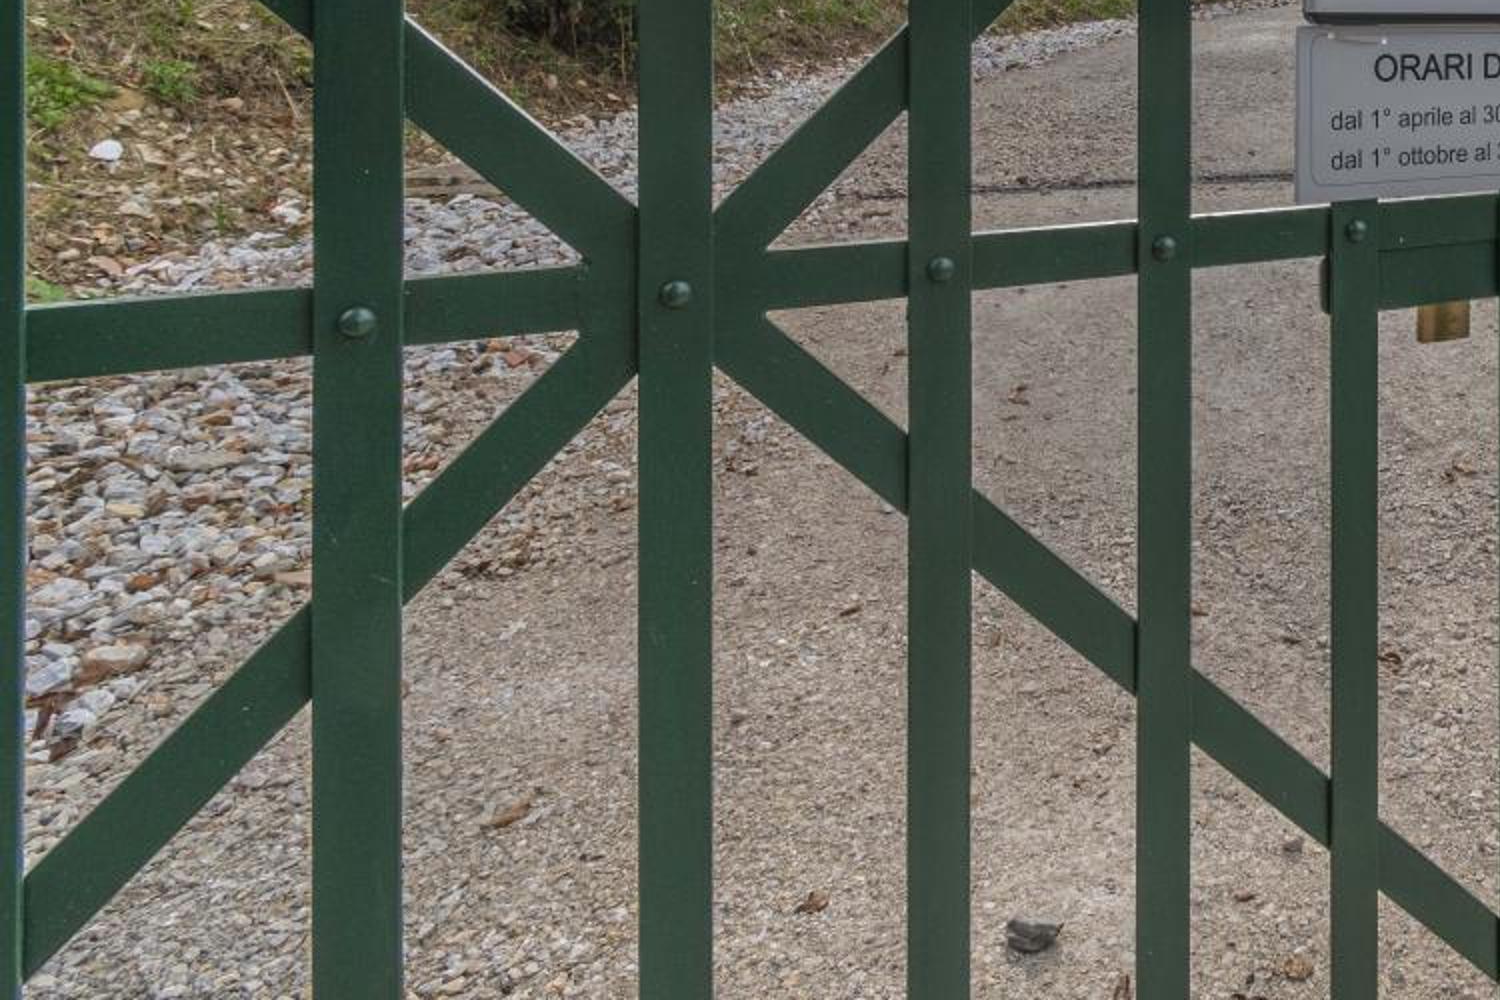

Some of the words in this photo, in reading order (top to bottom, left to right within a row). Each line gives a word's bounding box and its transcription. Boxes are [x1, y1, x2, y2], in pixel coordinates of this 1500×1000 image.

[1374, 52, 1473, 83] ORARI
[1330, 110, 1362, 131] dal
[1398, 106, 1453, 132] aprile
[1459, 105, 1476, 125] al
[1330, 149, 1362, 171] dal
[1398, 145, 1468, 167] ottobre
[1474, 142, 1491, 162] al
